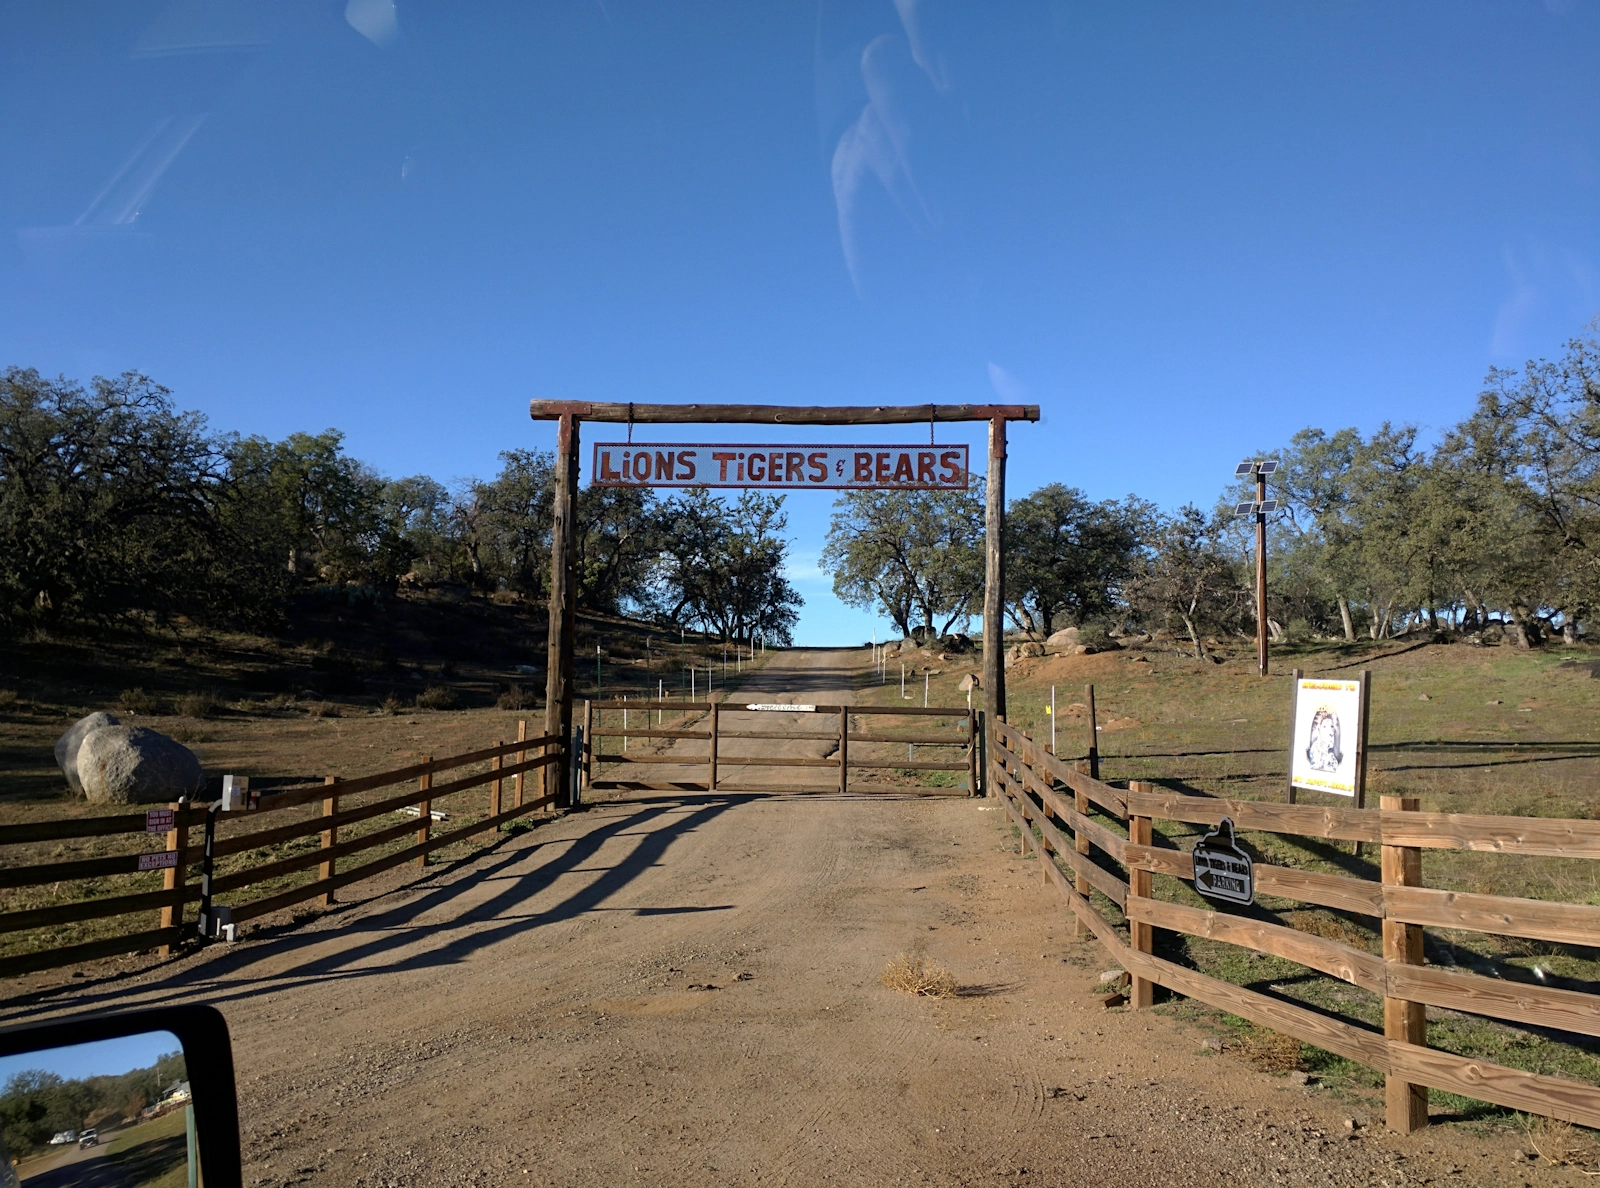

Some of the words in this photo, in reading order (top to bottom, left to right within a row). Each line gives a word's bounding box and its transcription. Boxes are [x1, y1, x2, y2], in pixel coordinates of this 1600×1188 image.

[835, 459, 846, 477] &
[854, 451, 961, 483] BEARS
[140, 859, 176, 868] EXCEPTIONS
[1212, 874, 1241, 892] PARKING
